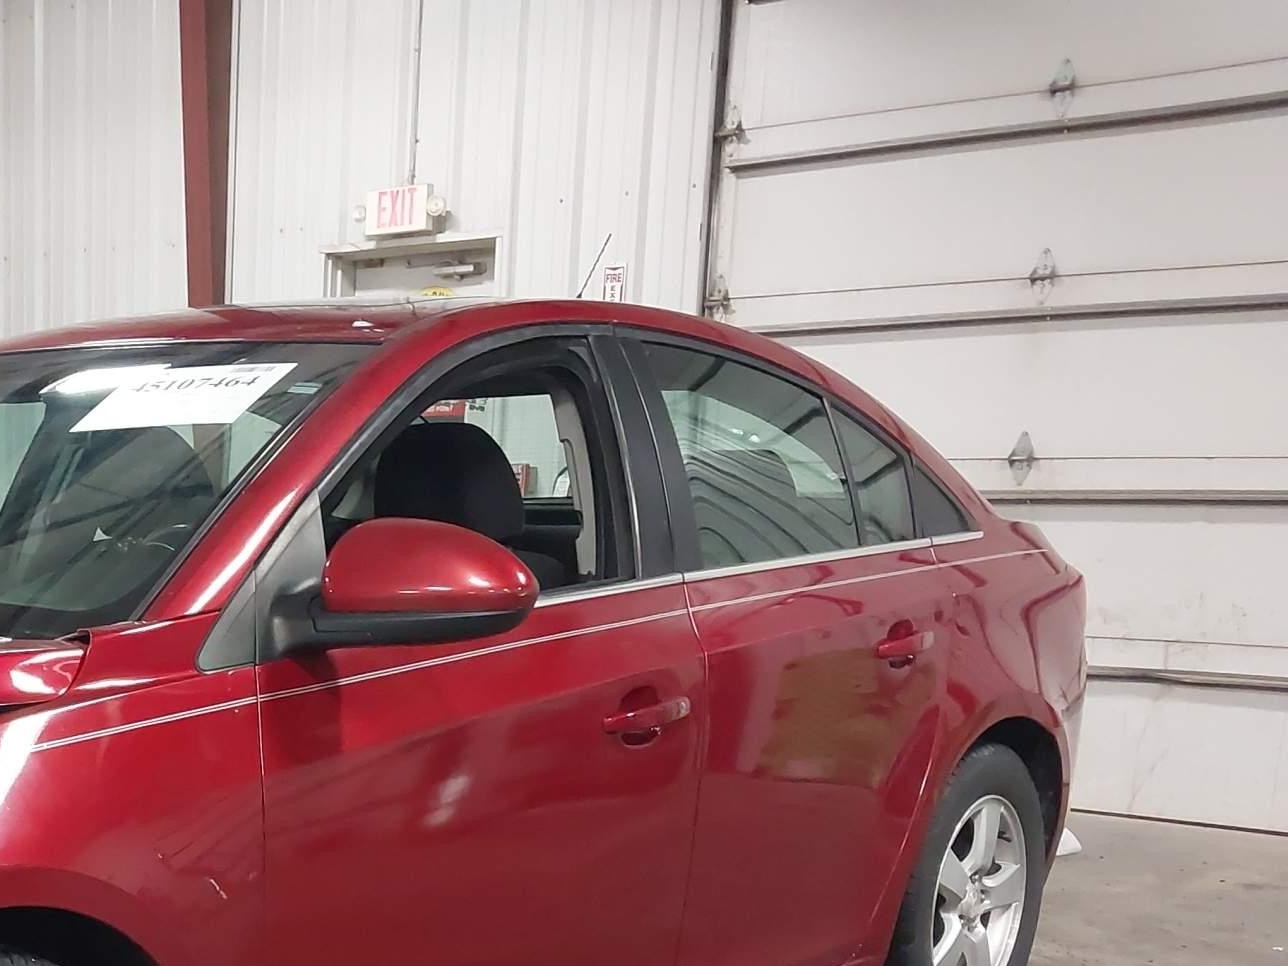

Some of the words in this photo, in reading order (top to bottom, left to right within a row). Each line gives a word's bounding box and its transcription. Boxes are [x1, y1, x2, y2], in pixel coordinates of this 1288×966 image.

[377, 187, 417, 229] EXIT
[605, 272, 622, 284] FIRE
[131, 375, 261, 393] 45107464
